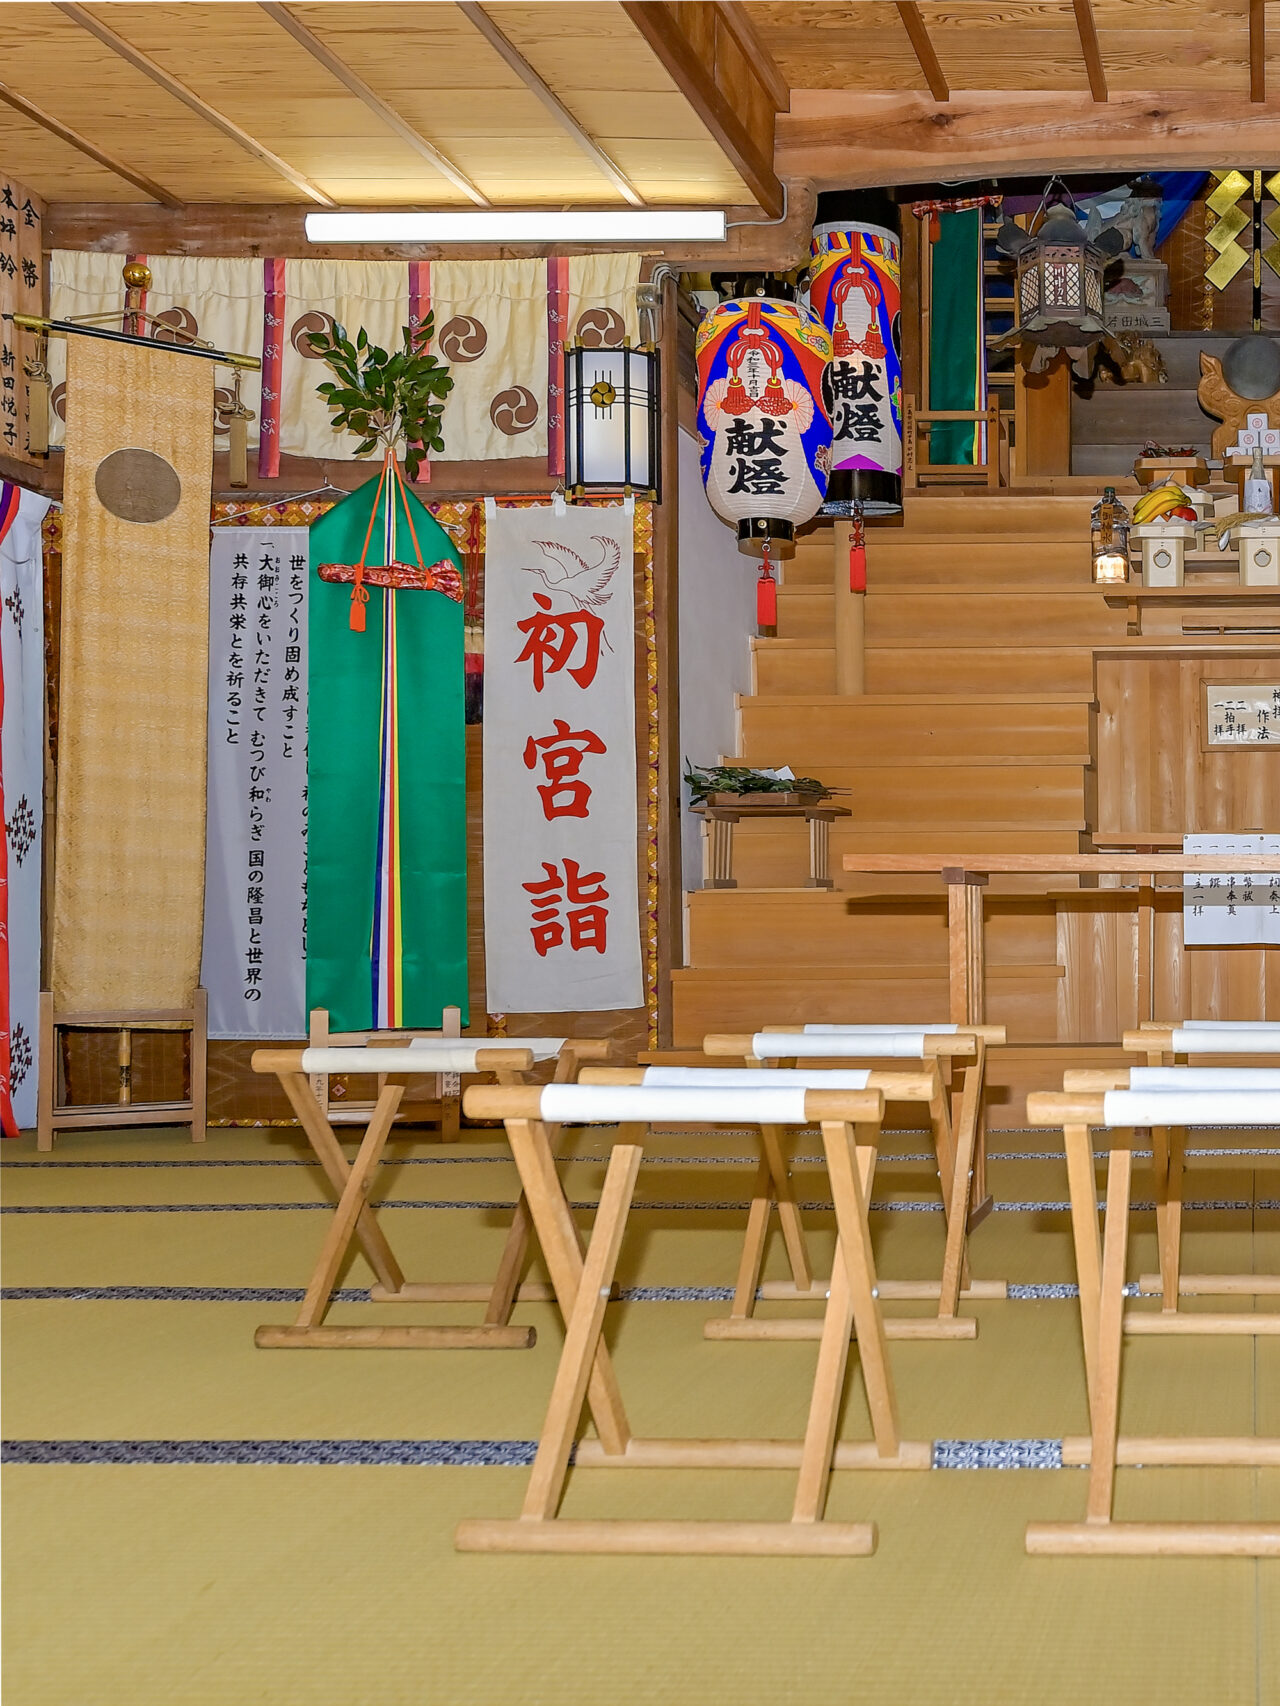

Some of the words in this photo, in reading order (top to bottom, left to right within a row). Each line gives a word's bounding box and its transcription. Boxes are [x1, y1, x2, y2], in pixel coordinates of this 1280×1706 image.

[1, 344, 17, 446] 新田悦子
[226, 553, 250, 745] 共存共栄とを祈ること
[281, 553, 307, 759] 世をつくり固め成すこと
[514, 592, 610, 957] 初宮詣
[244, 849, 265, 1002] 国の隆昌と世界の
